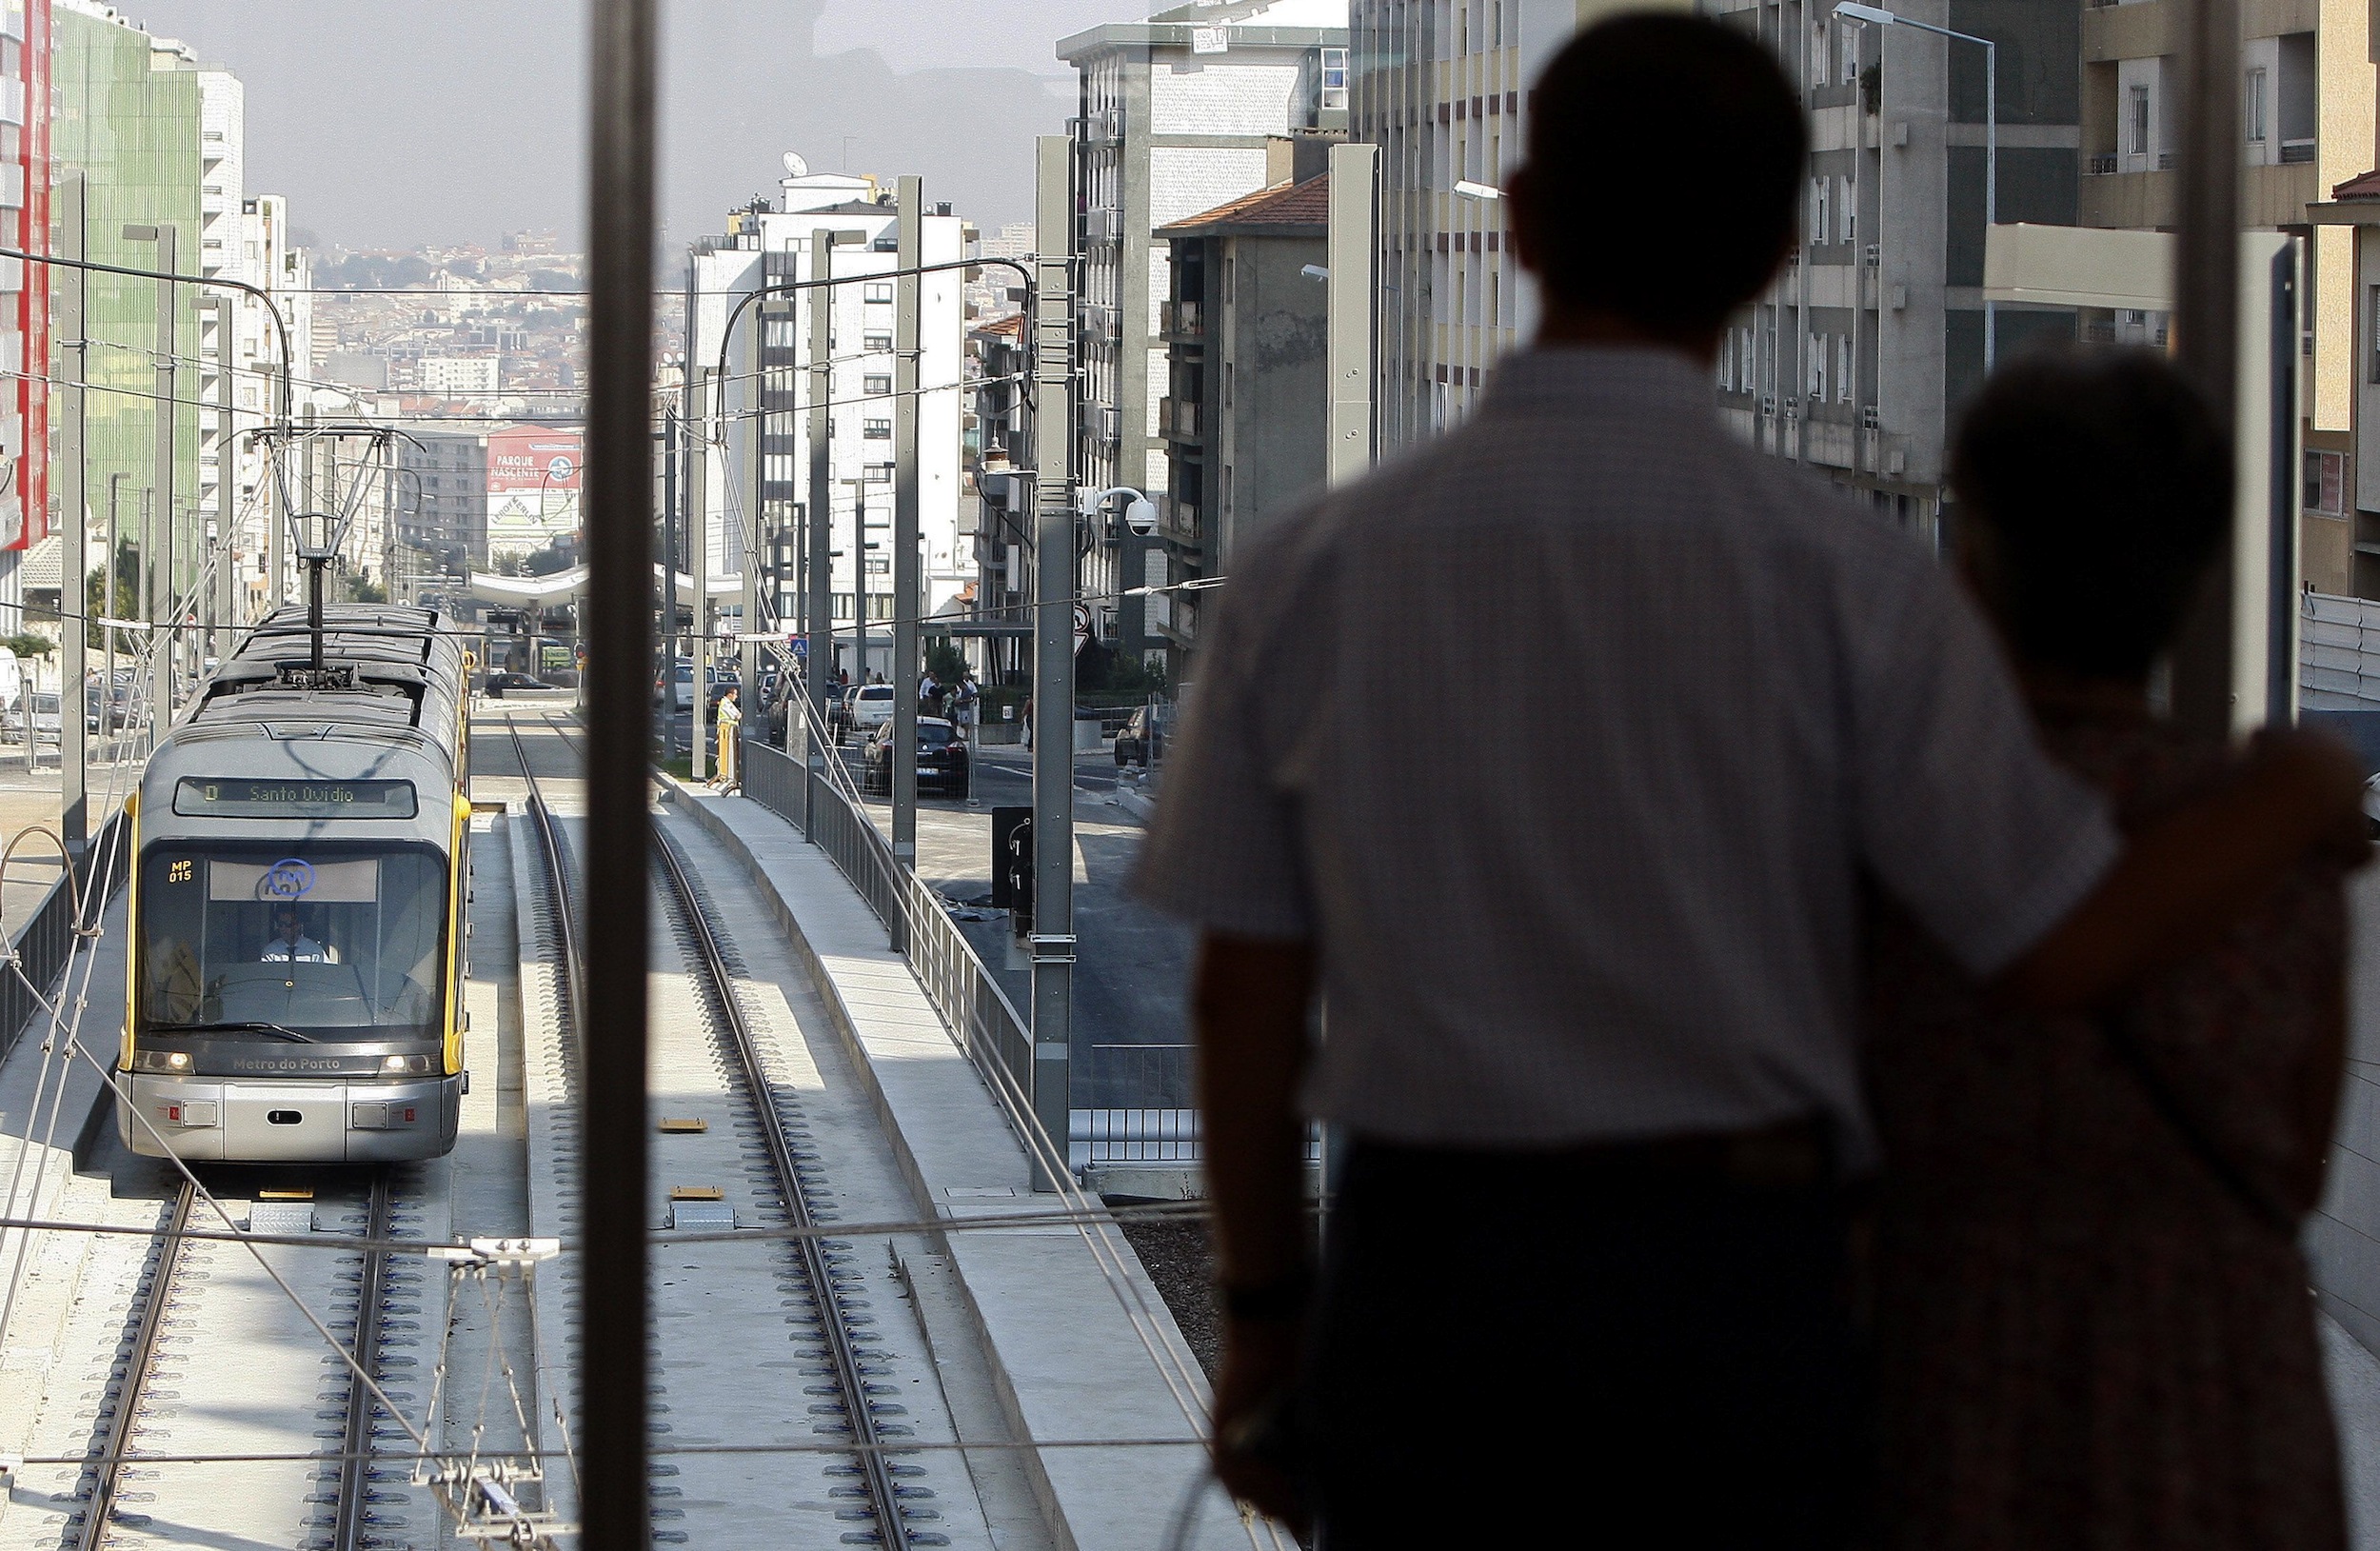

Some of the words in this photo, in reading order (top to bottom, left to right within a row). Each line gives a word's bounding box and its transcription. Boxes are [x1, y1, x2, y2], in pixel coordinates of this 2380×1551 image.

[496, 456, 534, 467] PARQUE
[490, 467, 540, 477] NASCENTE
[491, 501, 513, 524] LEROY
[511, 496, 538, 525] MERLIN
[249, 785, 297, 802] Santo
[171, 860, 192, 872] MP
[169, 869, 192, 883] 015
[233, 1058, 276, 1070] Metro
[279, 1058, 297, 1070] do
[300, 1058, 341, 1070] Porto
